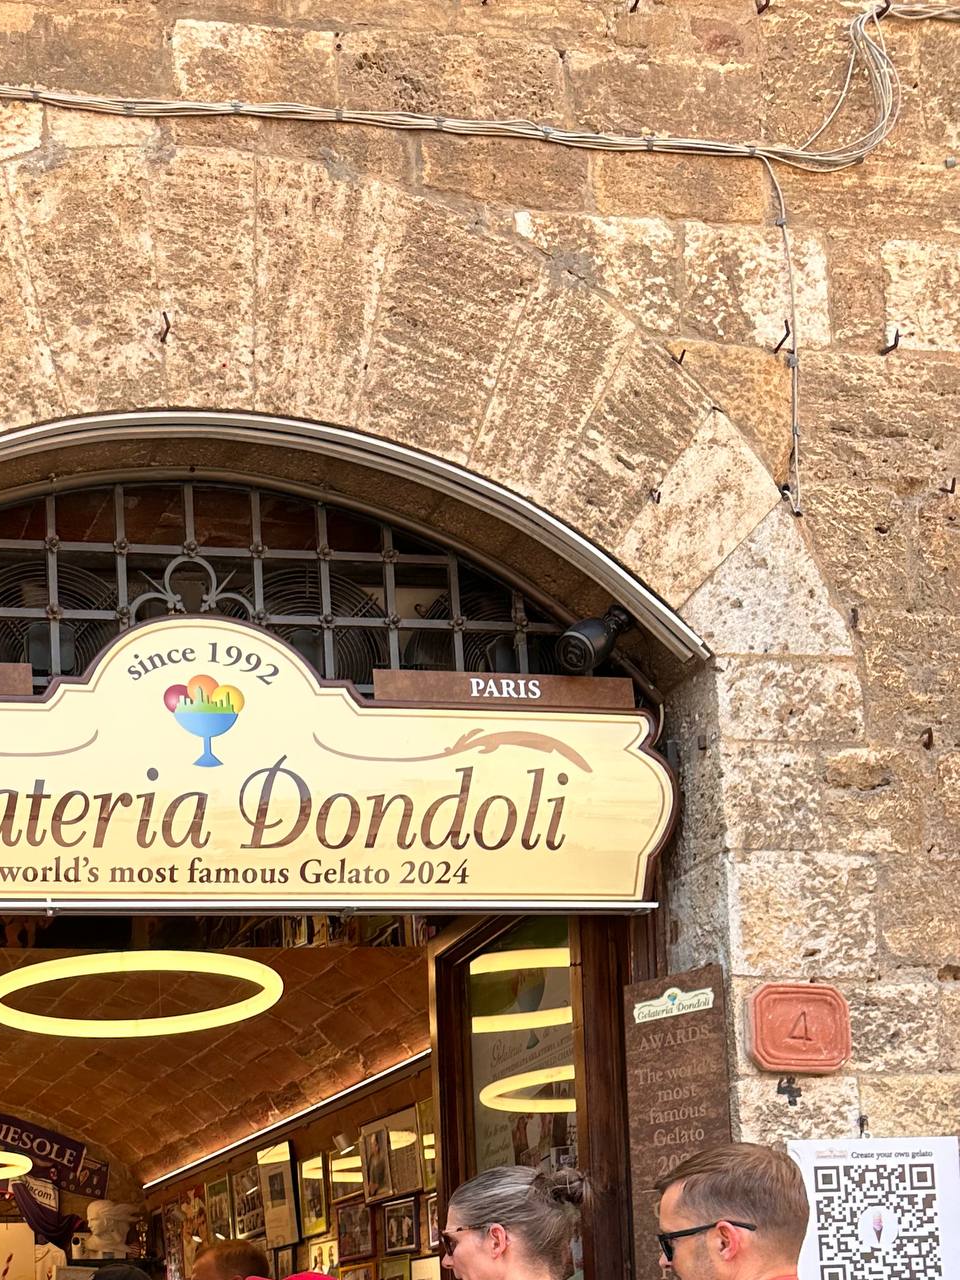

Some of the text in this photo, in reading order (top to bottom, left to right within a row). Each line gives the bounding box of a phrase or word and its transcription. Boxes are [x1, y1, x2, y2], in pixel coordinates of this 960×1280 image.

[127, 642, 280, 685] since 1992
[470, 678, 541, 699] PARIS
[239, 754, 569, 851] Dondoli
[109, 862, 179, 884] most
[187, 856, 289, 884] famous
[299, 858, 391, 884] Gelato
[399, 857, 470, 885] 2024
[637, 998, 710, 1021] Gelateria Dondoli
[640, 1024, 710, 1050] AWARDS
[635, 1068, 663, 1085] The
[657, 1085, 697, 1102] most
[650, 1103, 707, 1124] famous
[654, 1127, 705, 1147] Gelato
[851, 1151, 875, 1159] Create
[876, 1152, 893, 1161] your
[911, 1150, 933, 1160] gelato
